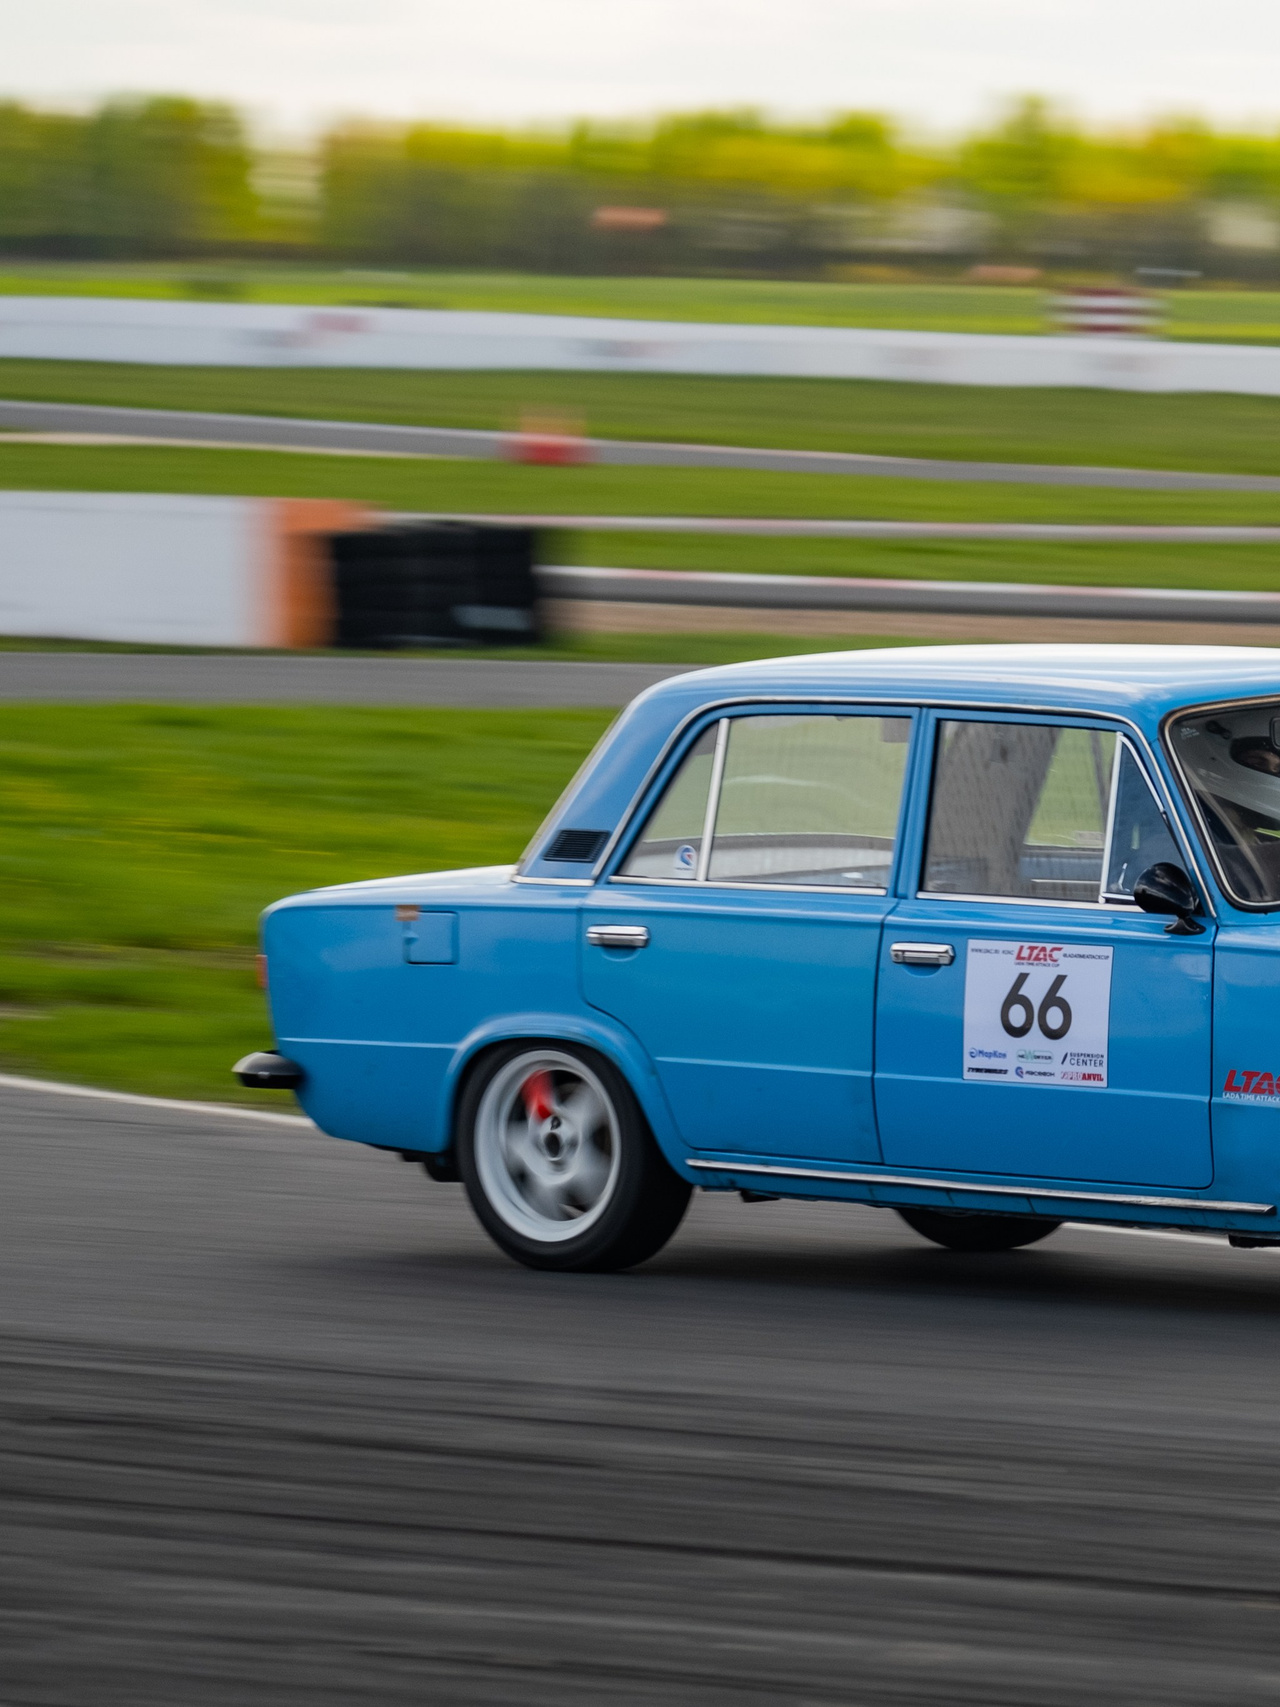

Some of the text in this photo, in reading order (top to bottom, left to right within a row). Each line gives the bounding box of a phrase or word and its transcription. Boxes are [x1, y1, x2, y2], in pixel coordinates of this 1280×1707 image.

[1015, 945, 1063, 963] LTAC
[1000, 972, 1072, 1041] 66
[1069, 1058, 1104, 1068] CENTER
[1240, 1093, 1255, 1101] TIME
[1256, 1095, 1280, 1103] ATTACK
